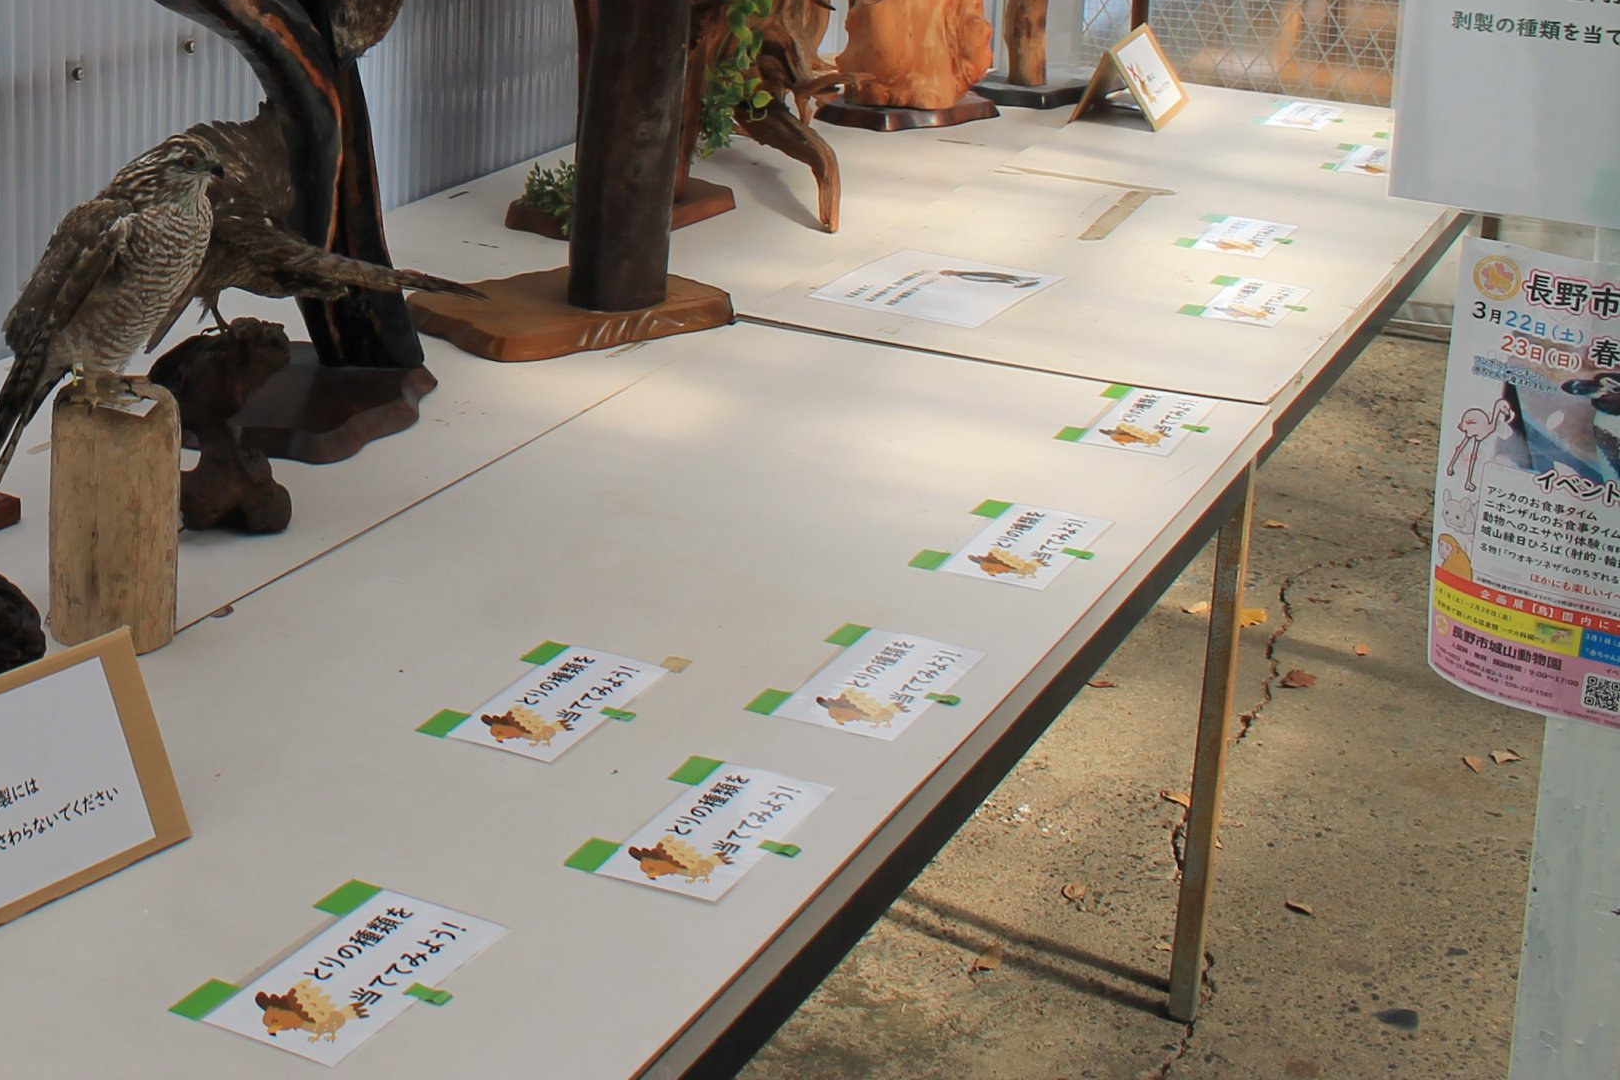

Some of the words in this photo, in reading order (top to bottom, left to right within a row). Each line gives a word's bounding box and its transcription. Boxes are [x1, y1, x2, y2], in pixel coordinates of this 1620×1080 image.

[1452, 10, 1620, 46] 剥製の種類を当て
[1526, 274, 1620, 317] 長野市
[1472, 301, 1584, 344] 3月22日（土）
[1500, 335, 1582, 371] 23日（日）
[1591, 340, 1620, 367] 春
[1486, 485, 1598, 521] アシカのお食事タイム
[1538, 472, 1620, 503] イベント
[991, 511, 1046, 549] とりの種類を
[1484, 500, 1620, 539] ニホンザルのお食事タイム
[1481, 524, 1620, 568] 城山縁日ひろば（射的・輪
[845, 639, 916, 689] とりの種類を
[1452, 625, 1562, 671] 長野市城山動物園
[515, 654, 596, 706] とりの種類を
[556, 664, 642, 722] 当ててみよう！
[888, 649, 964, 705] 当ててみよう！
[665, 774, 751, 836] とりの種類を
[712, 784, 803, 855] 当ててみよう！
[302, 905, 415, 982] とりの種類を
[348, 921, 468, 1007] 当ててみよう！
